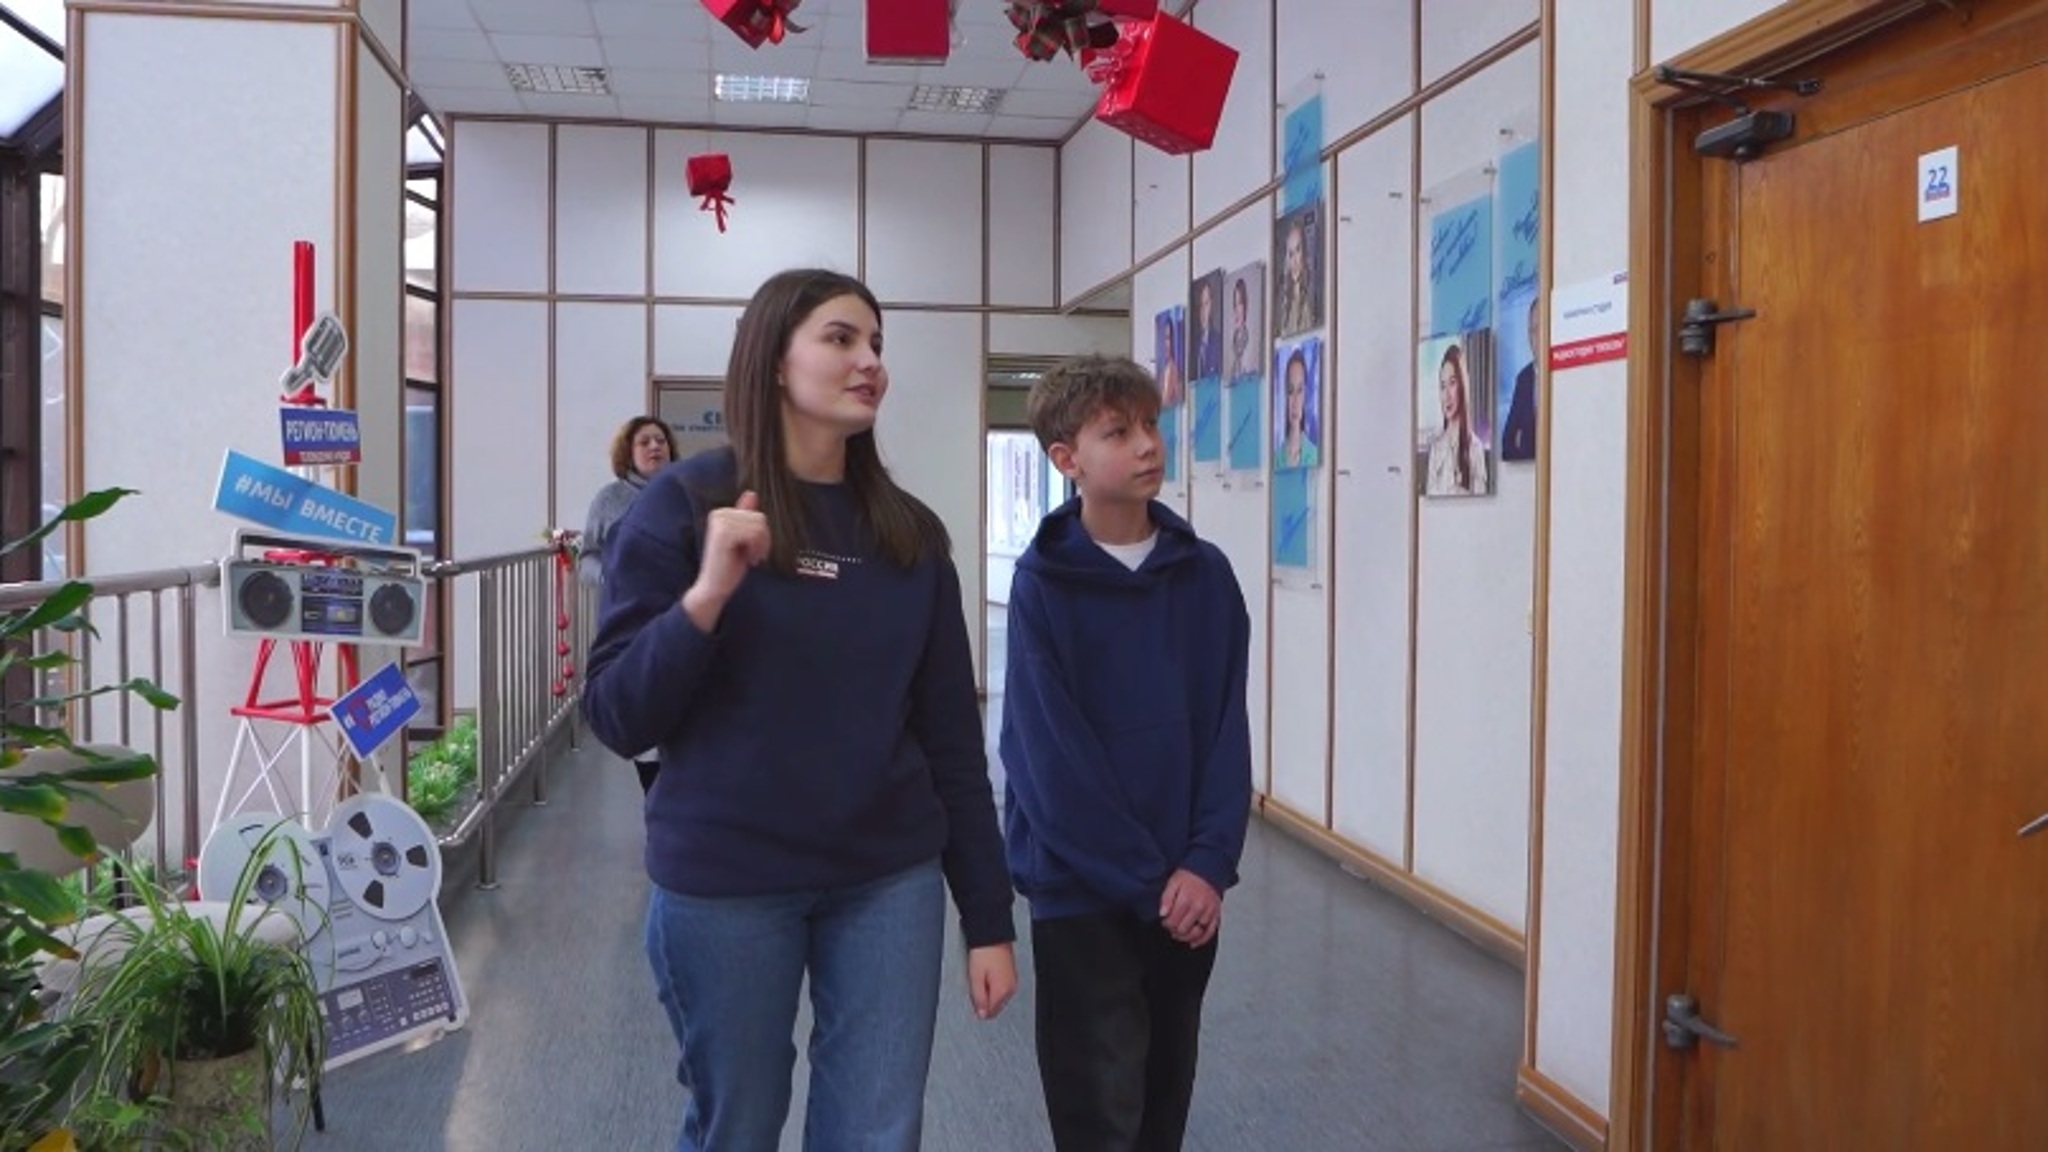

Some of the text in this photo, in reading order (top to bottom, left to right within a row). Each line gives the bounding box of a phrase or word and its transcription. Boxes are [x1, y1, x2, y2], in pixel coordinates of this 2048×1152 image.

[1928, 167, 1948, 190] 22
[235, 474, 383, 544] #МЫ ВМЕСТЕ
